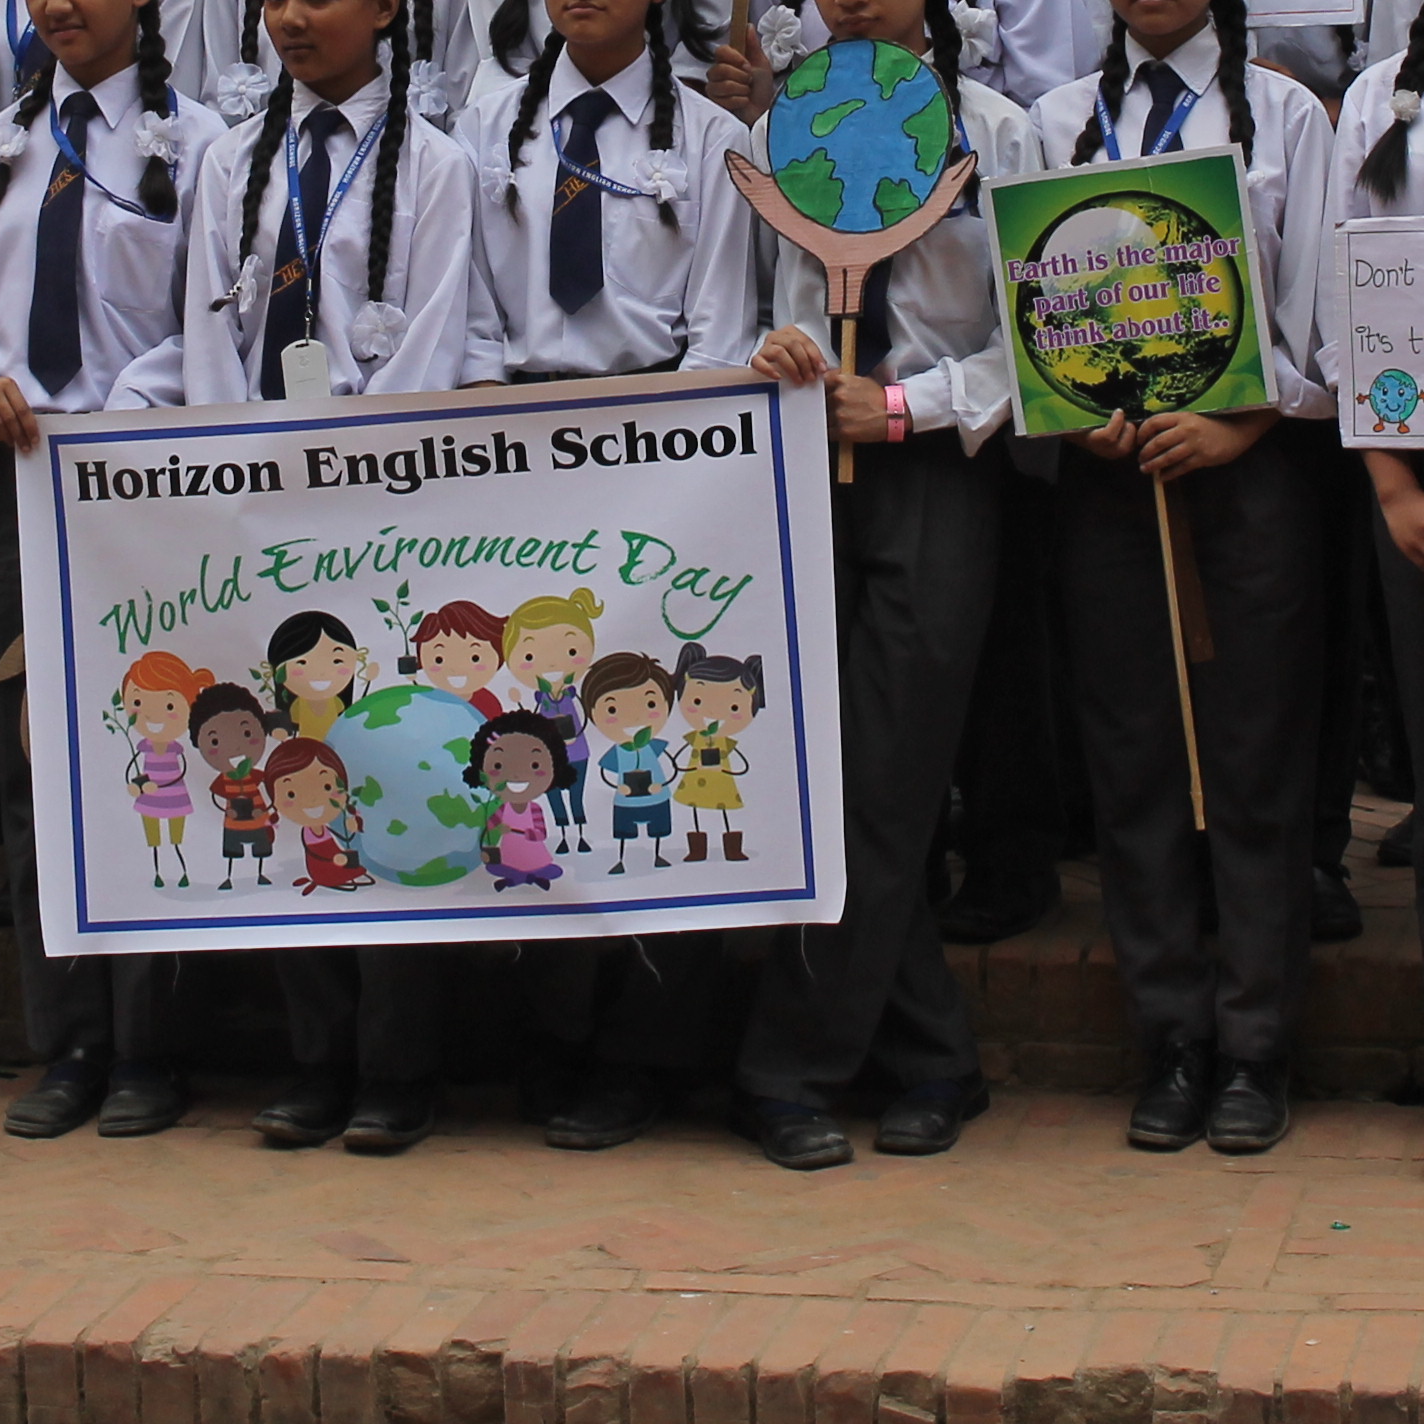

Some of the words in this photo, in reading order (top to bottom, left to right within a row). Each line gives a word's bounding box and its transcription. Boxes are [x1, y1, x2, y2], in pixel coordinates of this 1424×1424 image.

[1006, 253, 1078, 282] Earth
[1087, 250, 1109, 273] is
[1116, 244, 1157, 267] the
[1165, 234, 1241, 264] major
[1355, 258, 1415, 288] Don't
[1033, 288, 1089, 320] part
[1096, 281, 1124, 307] of
[1128, 280, 1171, 303] our
[1179, 273, 1222, 297] life
[1035, 321, 1106, 351] think
[1112, 310, 1183, 340] about
[1191, 309, 1230, 332] it..
[1355, 326, 1393, 353] it's
[75, 455, 284, 503] Horizon
[303, 431, 529, 495] English
[550, 412, 757, 471] School
[99, 554, 251, 654] World
[257, 525, 601, 593] Environment
[618, 530, 753, 641] Day
